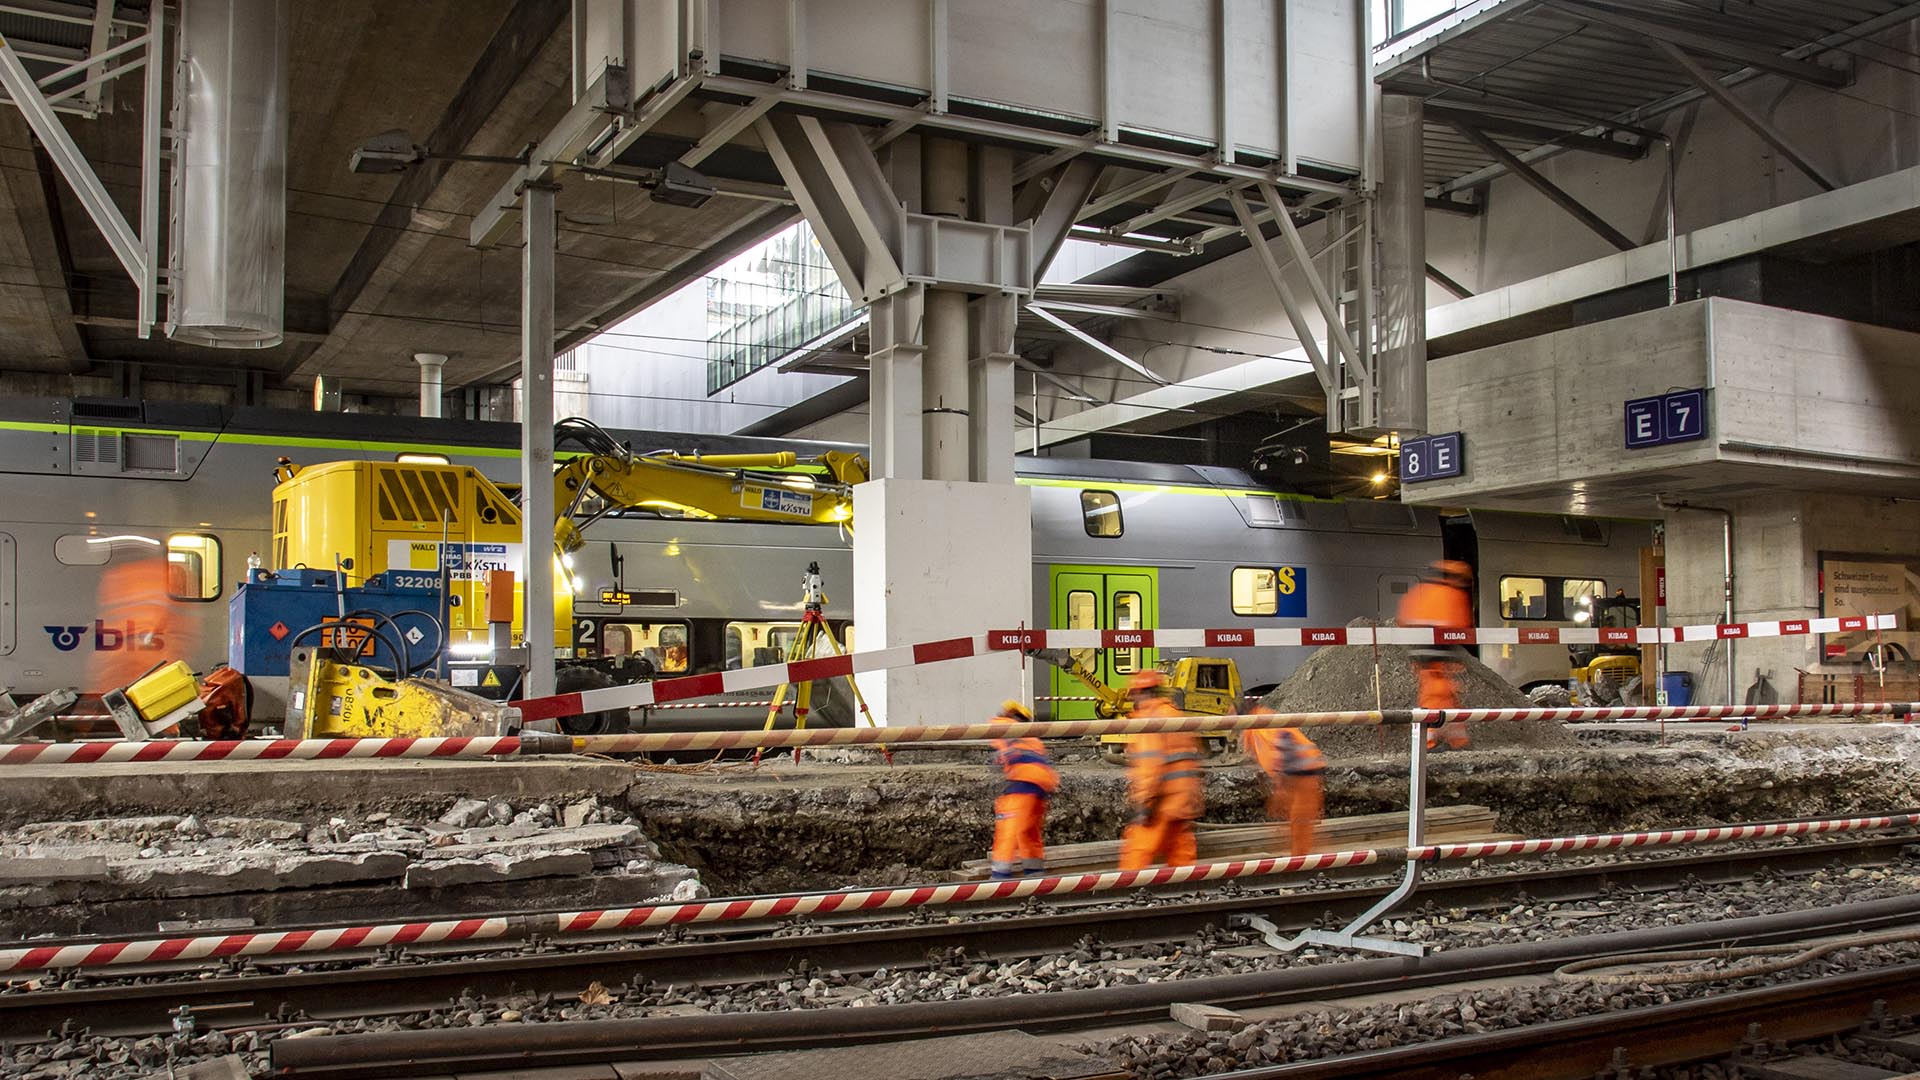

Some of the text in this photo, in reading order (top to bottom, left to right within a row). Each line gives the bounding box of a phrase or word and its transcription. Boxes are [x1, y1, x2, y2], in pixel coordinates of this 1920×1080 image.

[1637, 413, 1652, 438] E
[1676, 407, 1690, 432] 7
[1408, 453, 1419, 474] 8
[1438, 448, 1450, 469] E
[395, 576, 441, 588] 32208
[95, 619, 165, 652] bls
[579, 620, 596, 643] 2
[1115, 635, 1142, 643] KIBAG
[1217, 634, 1242, 642] KIBAG
[1312, 633, 1336, 641] KIBAG
[1444, 632, 1466, 640] KIBAG
[1528, 632, 1550, 640] KIBAG
[1608, 632, 1629, 640] KIBAG
[1079, 666, 1102, 689] WALO
